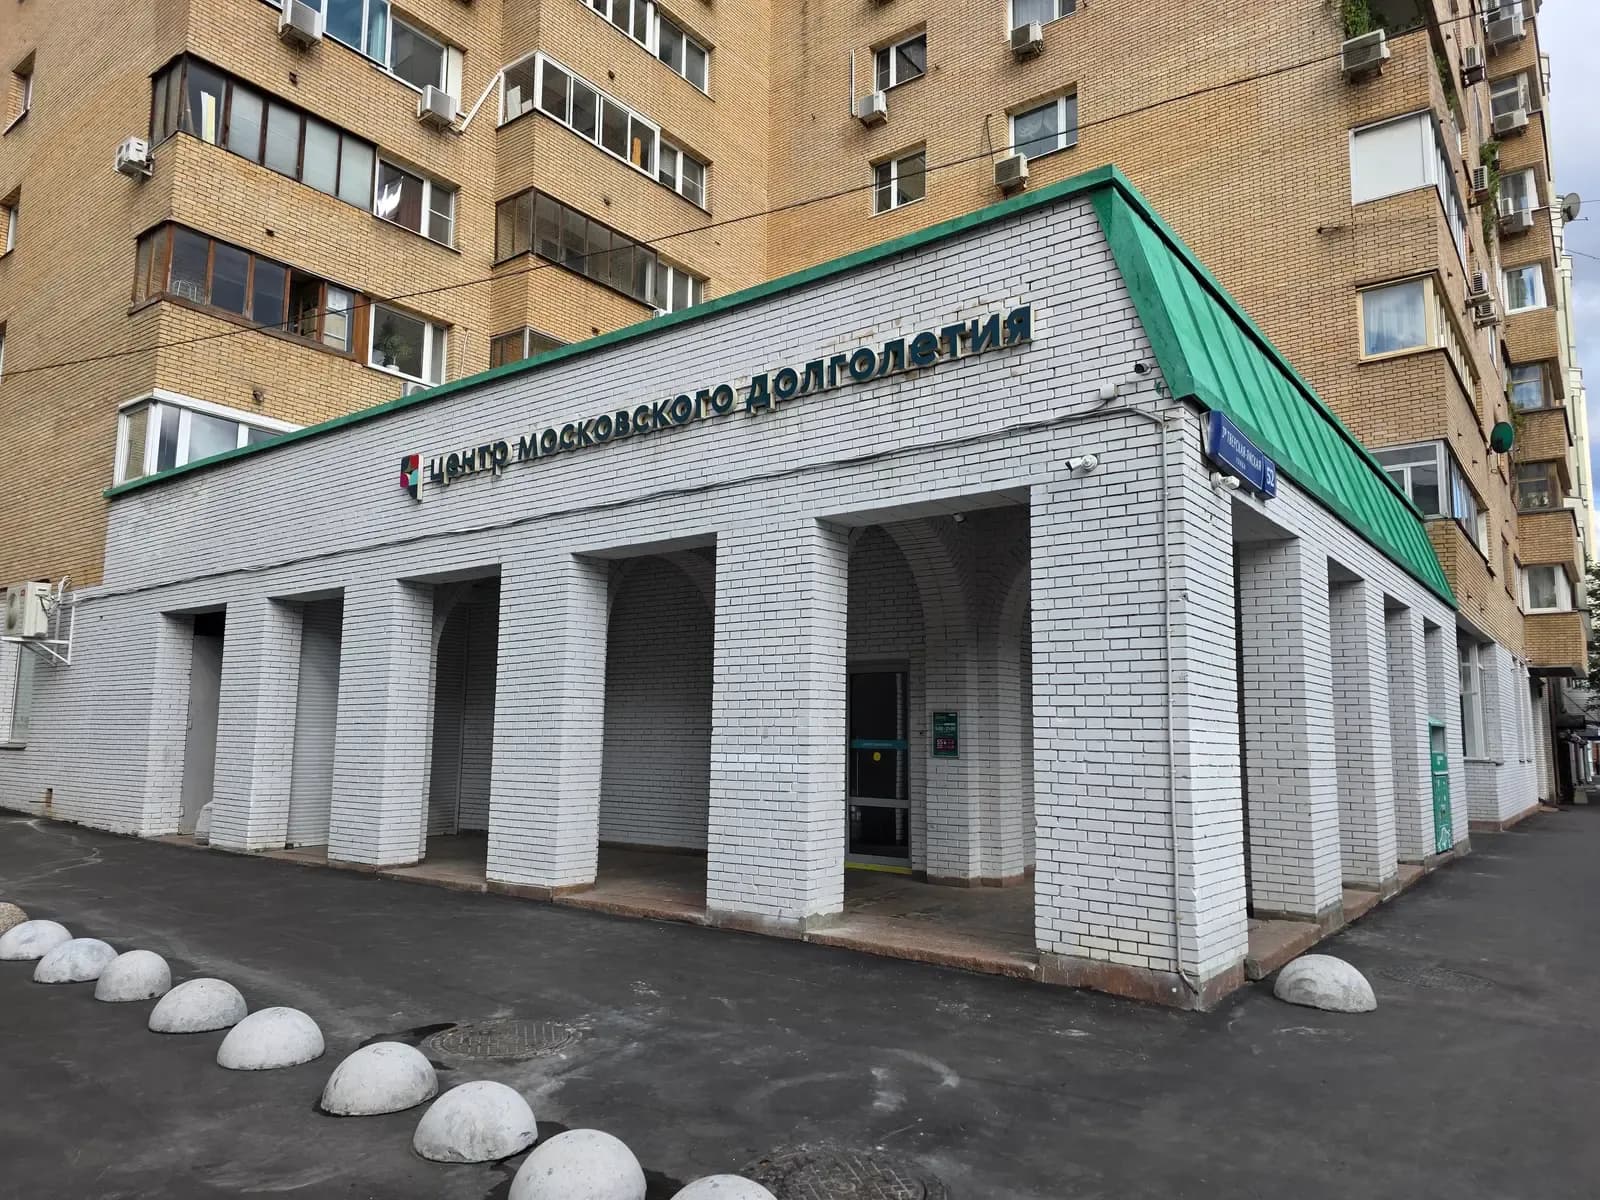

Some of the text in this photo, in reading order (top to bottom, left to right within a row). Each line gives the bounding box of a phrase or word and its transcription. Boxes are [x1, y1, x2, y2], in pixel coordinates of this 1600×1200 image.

[518, 384, 737, 460] московского
[745, 305, 1034, 414] долголетия
[1266, 466, 1275, 488] 52
